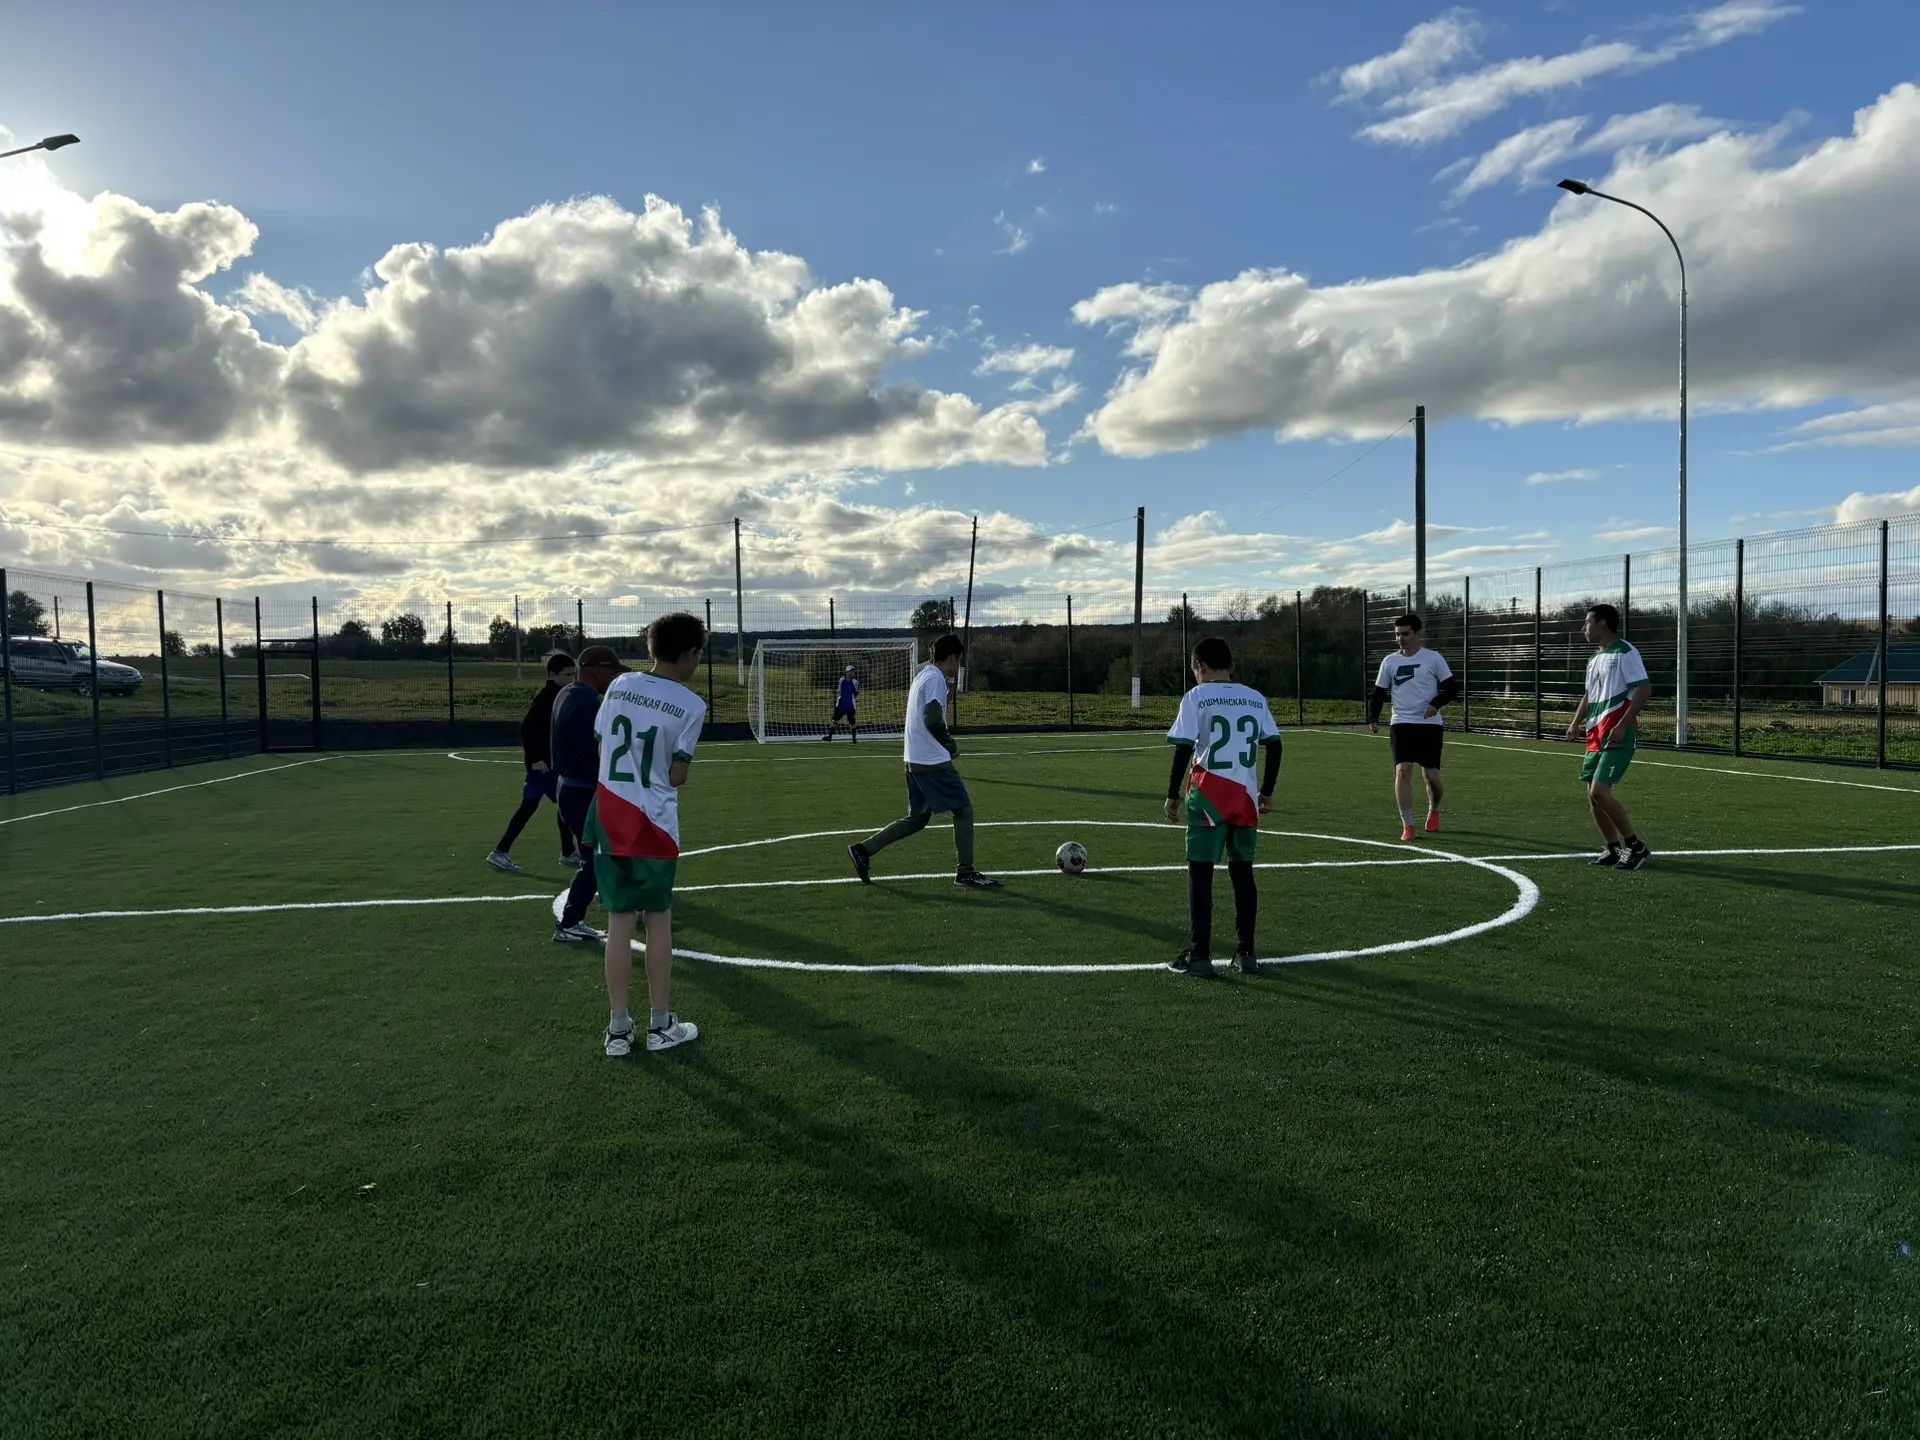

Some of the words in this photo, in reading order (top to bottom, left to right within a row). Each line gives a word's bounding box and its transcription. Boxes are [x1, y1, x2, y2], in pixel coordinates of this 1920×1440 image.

[661, 702, 685, 718] ООШ
[608, 714, 658, 788] 21
[1208, 715, 1259, 770] 23
